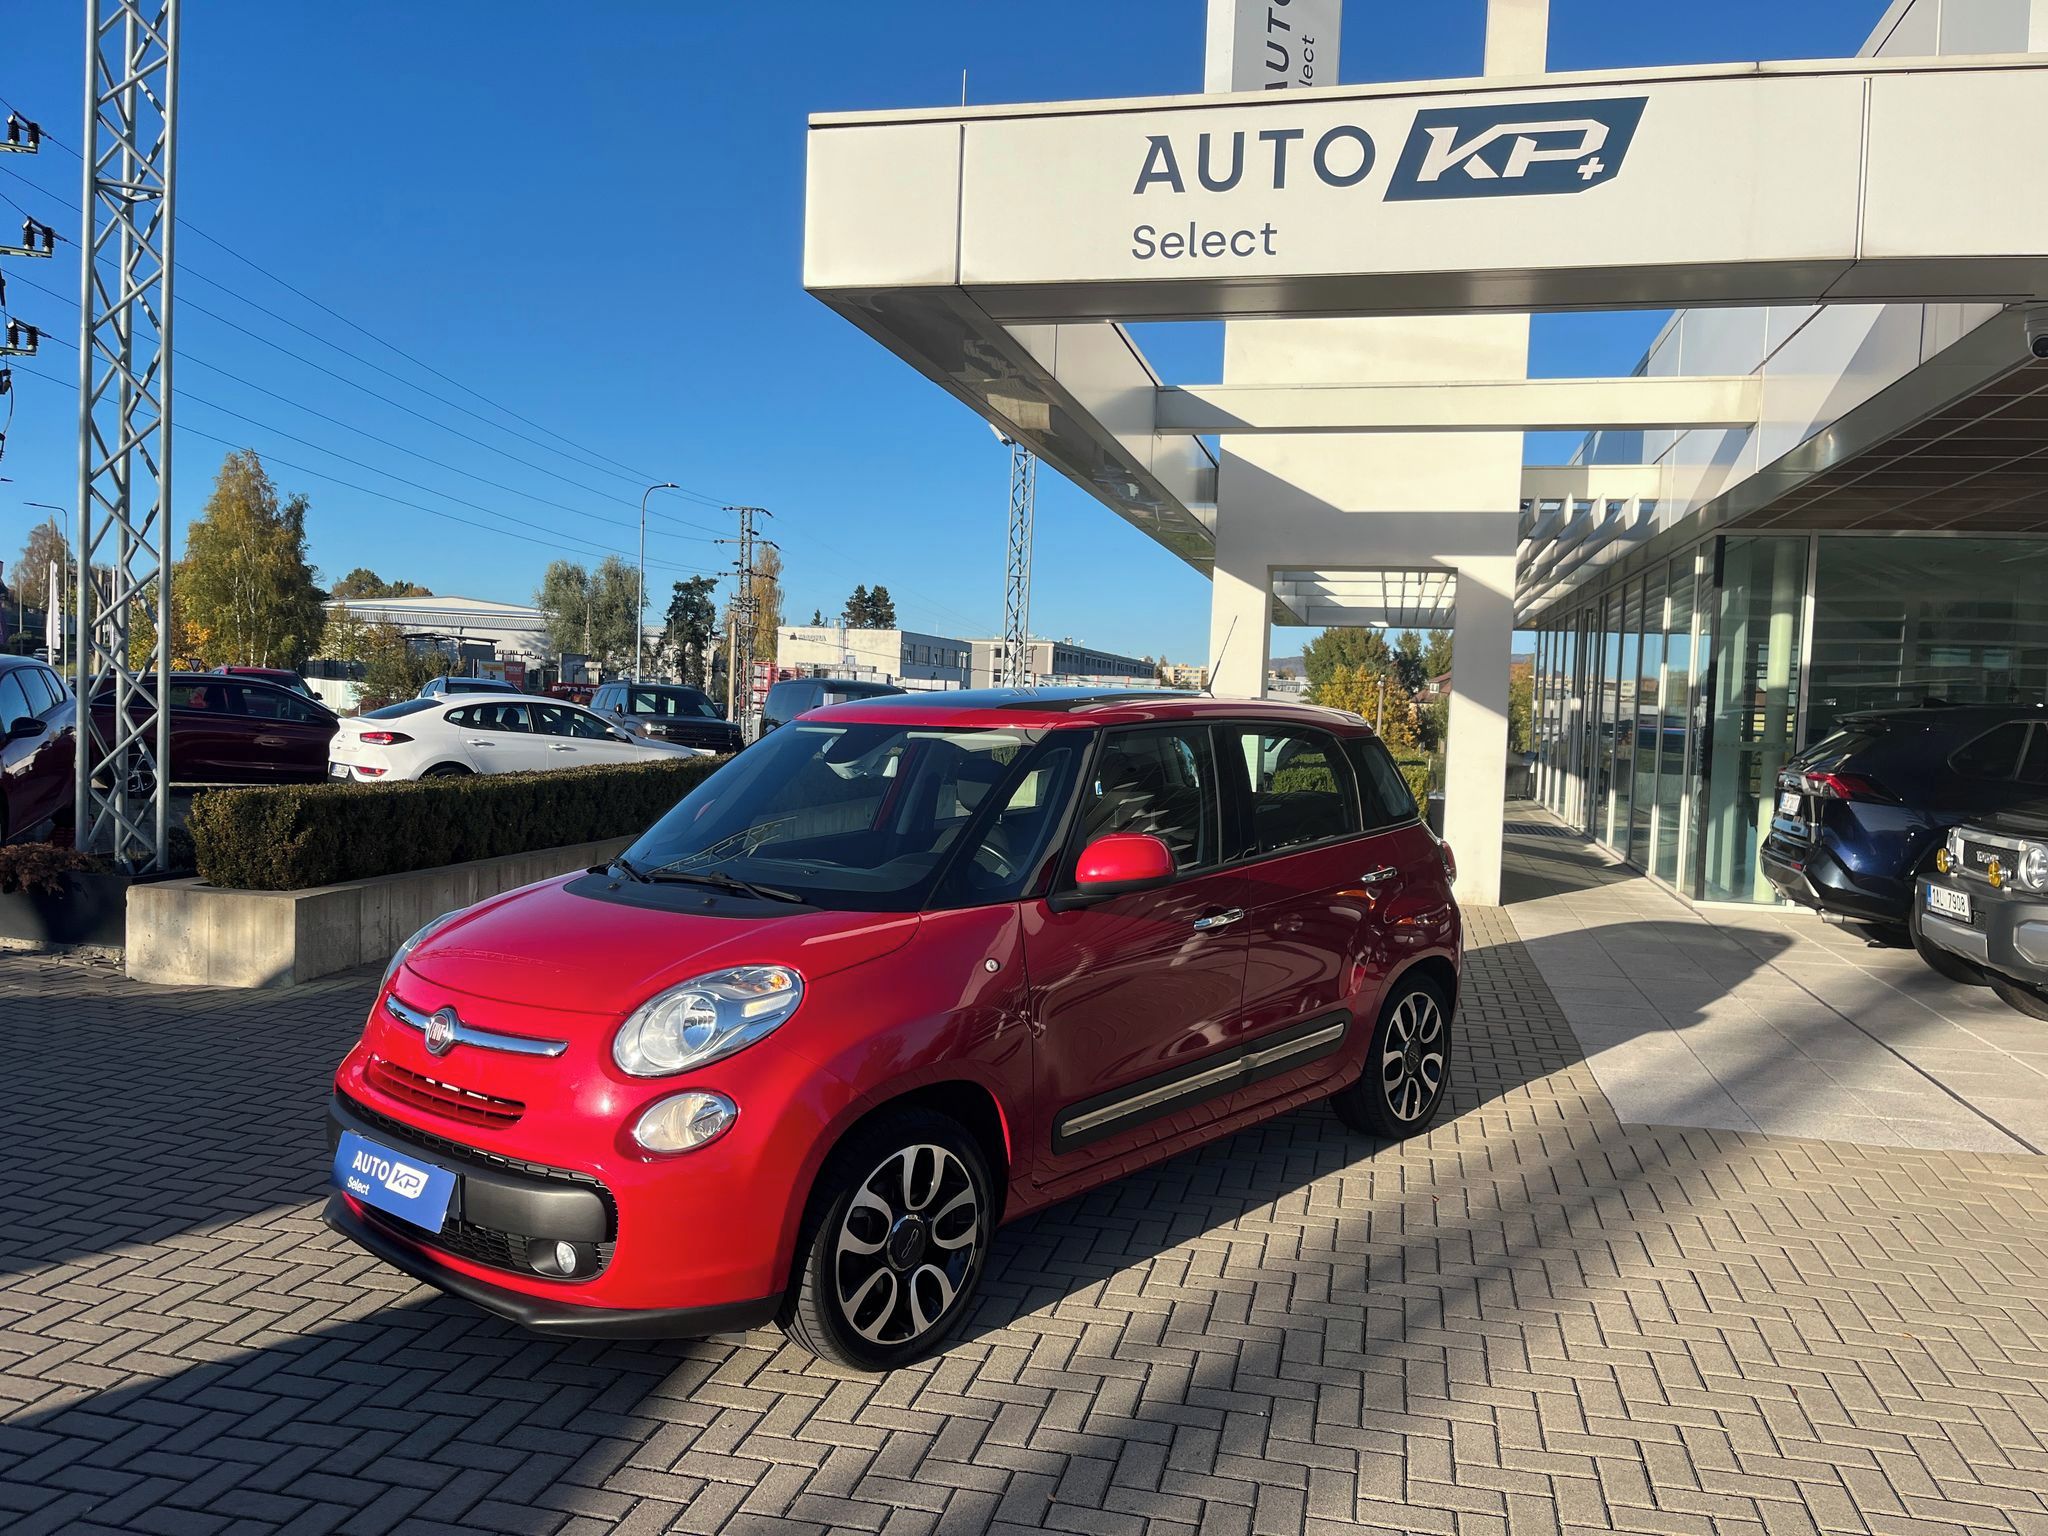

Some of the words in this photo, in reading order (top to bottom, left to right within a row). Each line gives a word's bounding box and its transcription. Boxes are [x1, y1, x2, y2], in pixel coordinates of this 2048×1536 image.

[1265, 0, 1291, 90] UT
[1299, 34, 1315, 87] lect
[1133, 125, 1376, 194] AUTO
[1132, 221, 1278, 260] Select
[1932, 888, 1944, 906] 1AL
[1948, 892, 1965, 912] 7908
[352, 1150, 390, 1181] AUTO
[347, 1176, 370, 1196] Select
